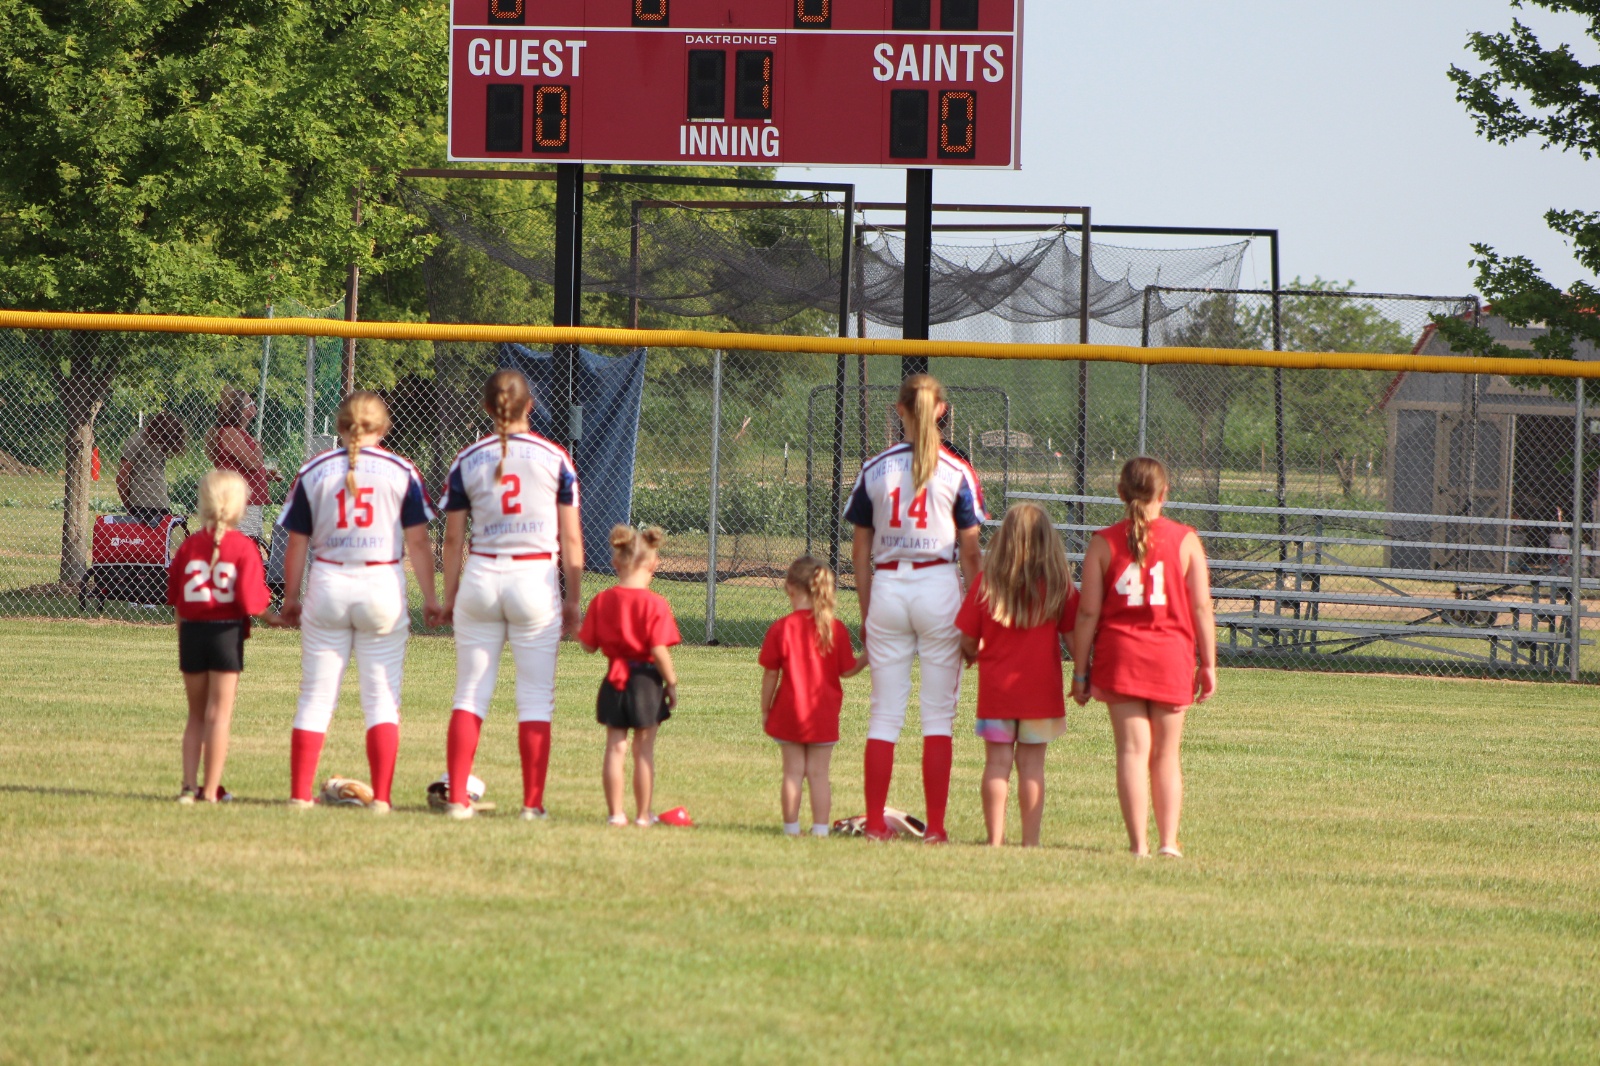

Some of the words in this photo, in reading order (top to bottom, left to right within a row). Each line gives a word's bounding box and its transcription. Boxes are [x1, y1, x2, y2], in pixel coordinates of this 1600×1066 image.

[467, 37, 587, 77] GUEST
[685, 34, 778, 45] DAKTRONICS
[872, 42, 1005, 83] SAINTS
[535, 86, 568, 147] 0
[940, 91, 974, 153] 0
[680, 125, 780, 157] INNING
[467, 447, 514, 473] AMERICN
[871, 458, 912, 482] AMERICA
[335, 487, 374, 529] 15
[501, 474, 522, 515] 2
[889, 486, 928, 529] 14
[880, 534, 939, 549] AUXILIARY
[184, 559, 237, 603] 29
[1115, 561, 1167, 606] 41
